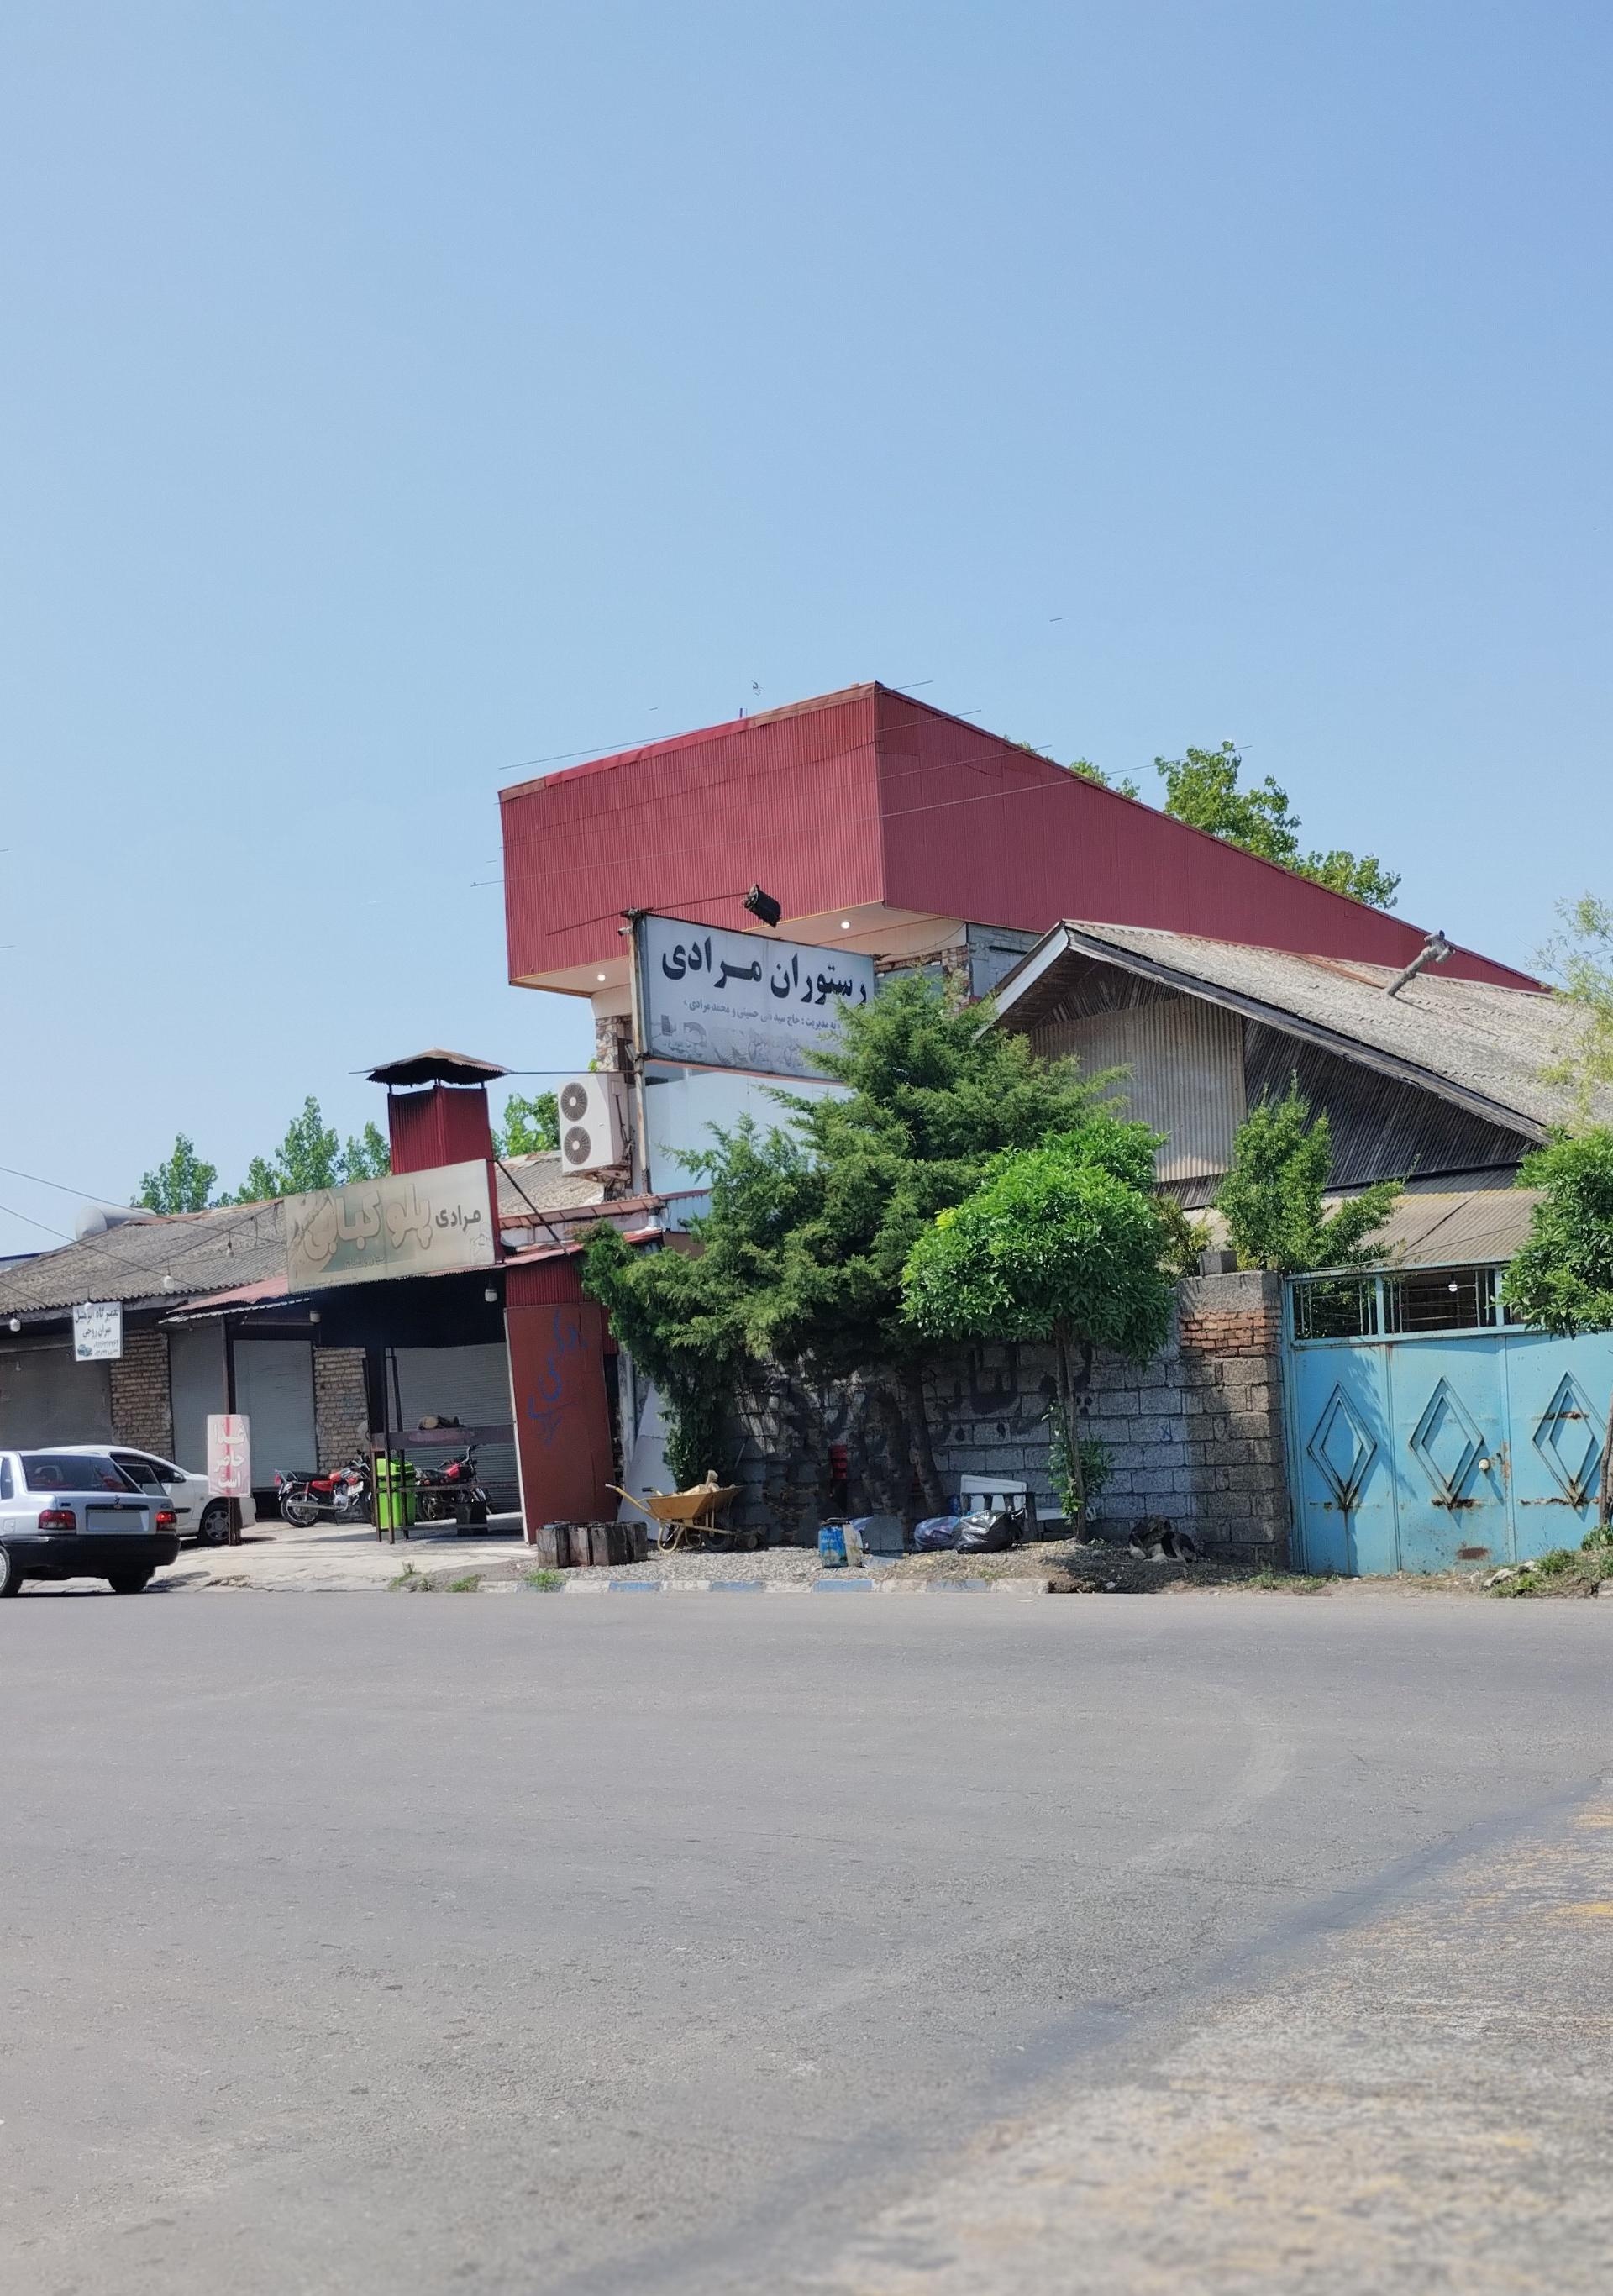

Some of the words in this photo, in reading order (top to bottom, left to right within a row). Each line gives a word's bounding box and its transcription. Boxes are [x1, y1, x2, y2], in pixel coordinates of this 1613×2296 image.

[662, 936, 763, 989] مرادی
[770, 954, 867, 1006] رستوران
[435, 1204, 481, 1231] مرادی
[213, 1422, 246, 1446] غذا
